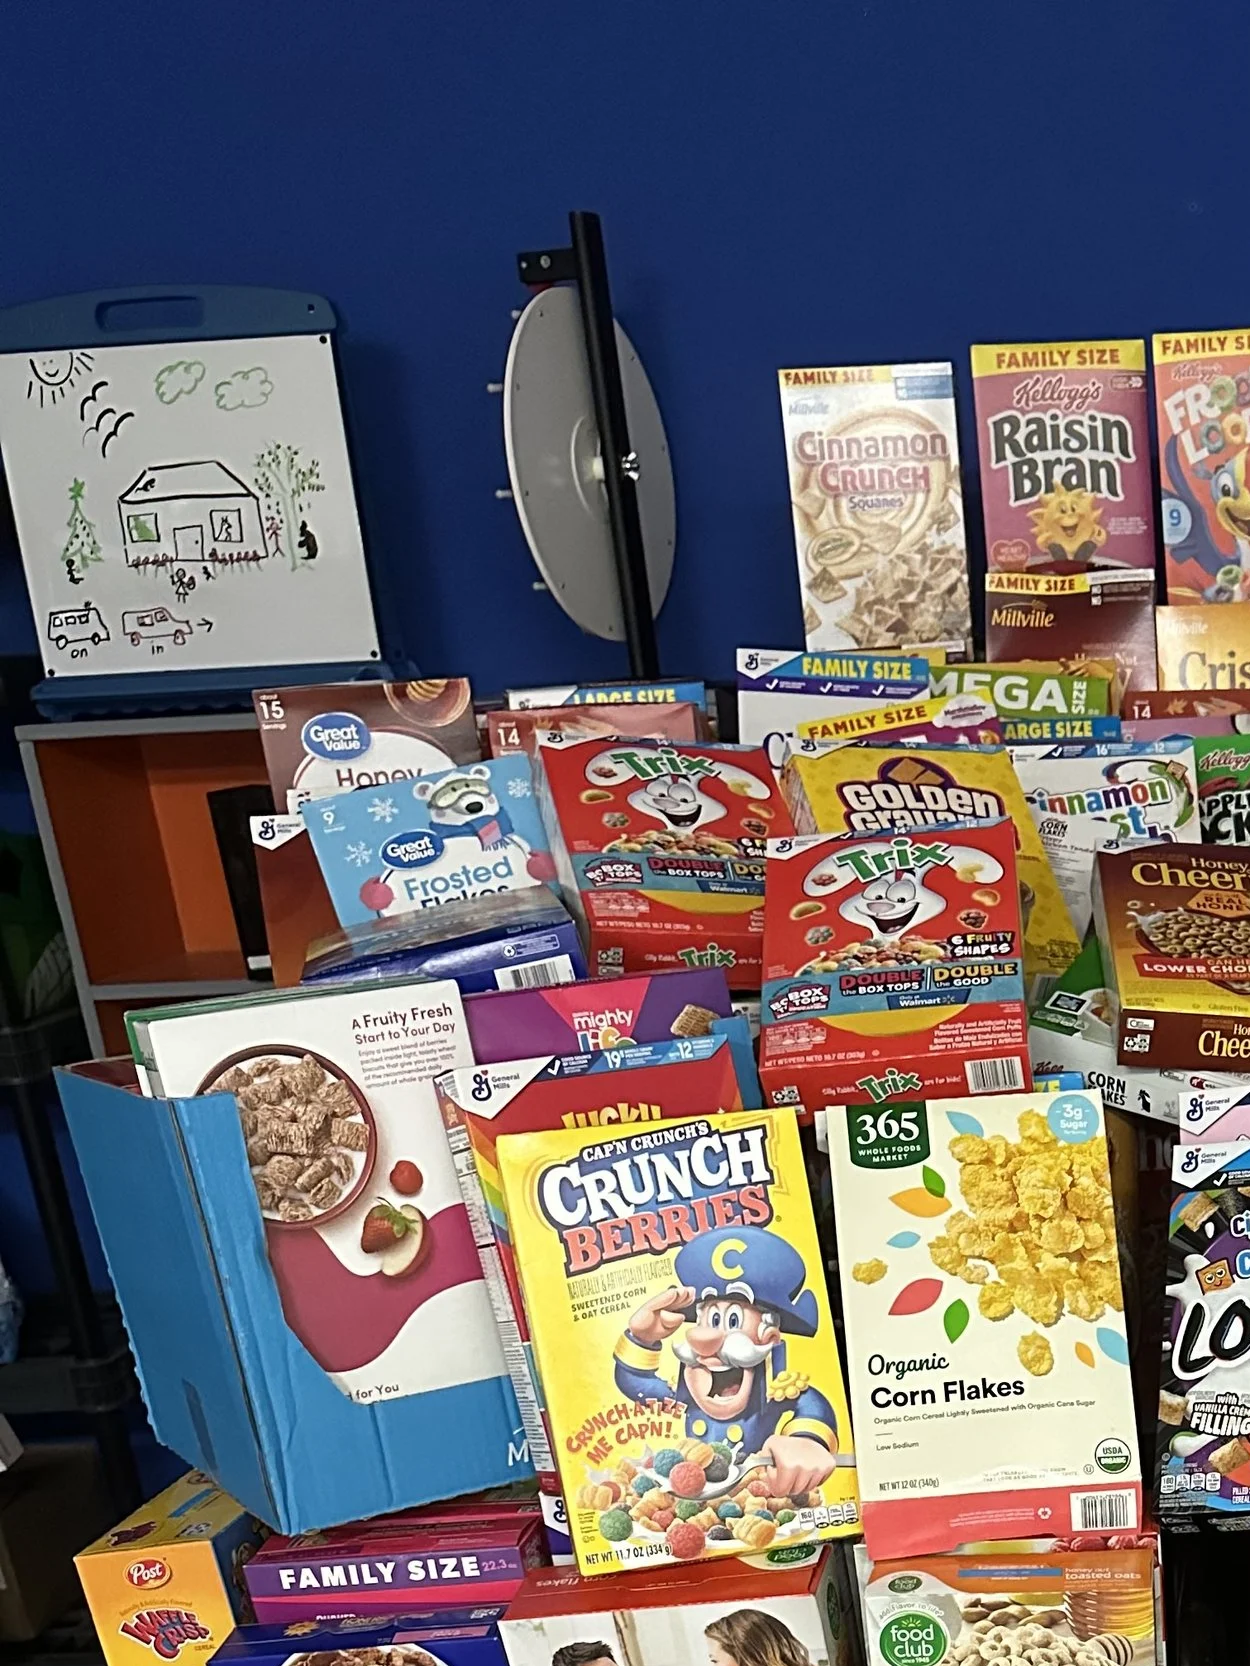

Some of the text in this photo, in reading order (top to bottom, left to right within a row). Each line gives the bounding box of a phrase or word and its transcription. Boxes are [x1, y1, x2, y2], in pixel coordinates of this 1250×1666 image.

[996, 348, 1120, 369] FAMILY SIZE
[1162, 336, 1230, 356] FAMILY
[1014, 377, 1102, 404] Kellogg's
[799, 431, 947, 459] Cinnamon
[991, 415, 1132, 462] Raisin
[819, 462, 930, 492] CRUNCH
[1010, 455, 1119, 502] Bran
[848, 495, 904, 509] Squares
[992, 605, 1056, 628] Millville
[71, 648, 88, 658] on
[152, 643, 163, 654] in
[310, 725, 359, 742] Great
[323, 738, 362, 752] Value
[611, 750, 719, 780] Trix
[837, 838, 950, 882] Trix
[1191, 858, 1249, 875] Honey
[403, 857, 513, 902] Frosted
[1144, 964, 1207, 974] LOWER
[352, 1003, 452, 1030] A Fruity Fresh
[355, 1020, 456, 1045] Start to Your Day
[855, 1109, 920, 1144] 365
[583, 1122, 709, 1162] CAP'N CRUNCH'S
[858, 1144, 921, 1156] WHOLE FOODS
[873, 1154, 909, 1162] MARKET
[542, 1128, 770, 1227] CRUNCH
[563, 1185, 771, 1271] BERRIES
[868, 1353, 949, 1380] Organic
[871, 1377, 1025, 1408] Corn Flakes
[279, 1555, 480, 1590] FAMILY SIZE
[889, 1626, 933, 1644] food
[894, 1641, 934, 1658] club
